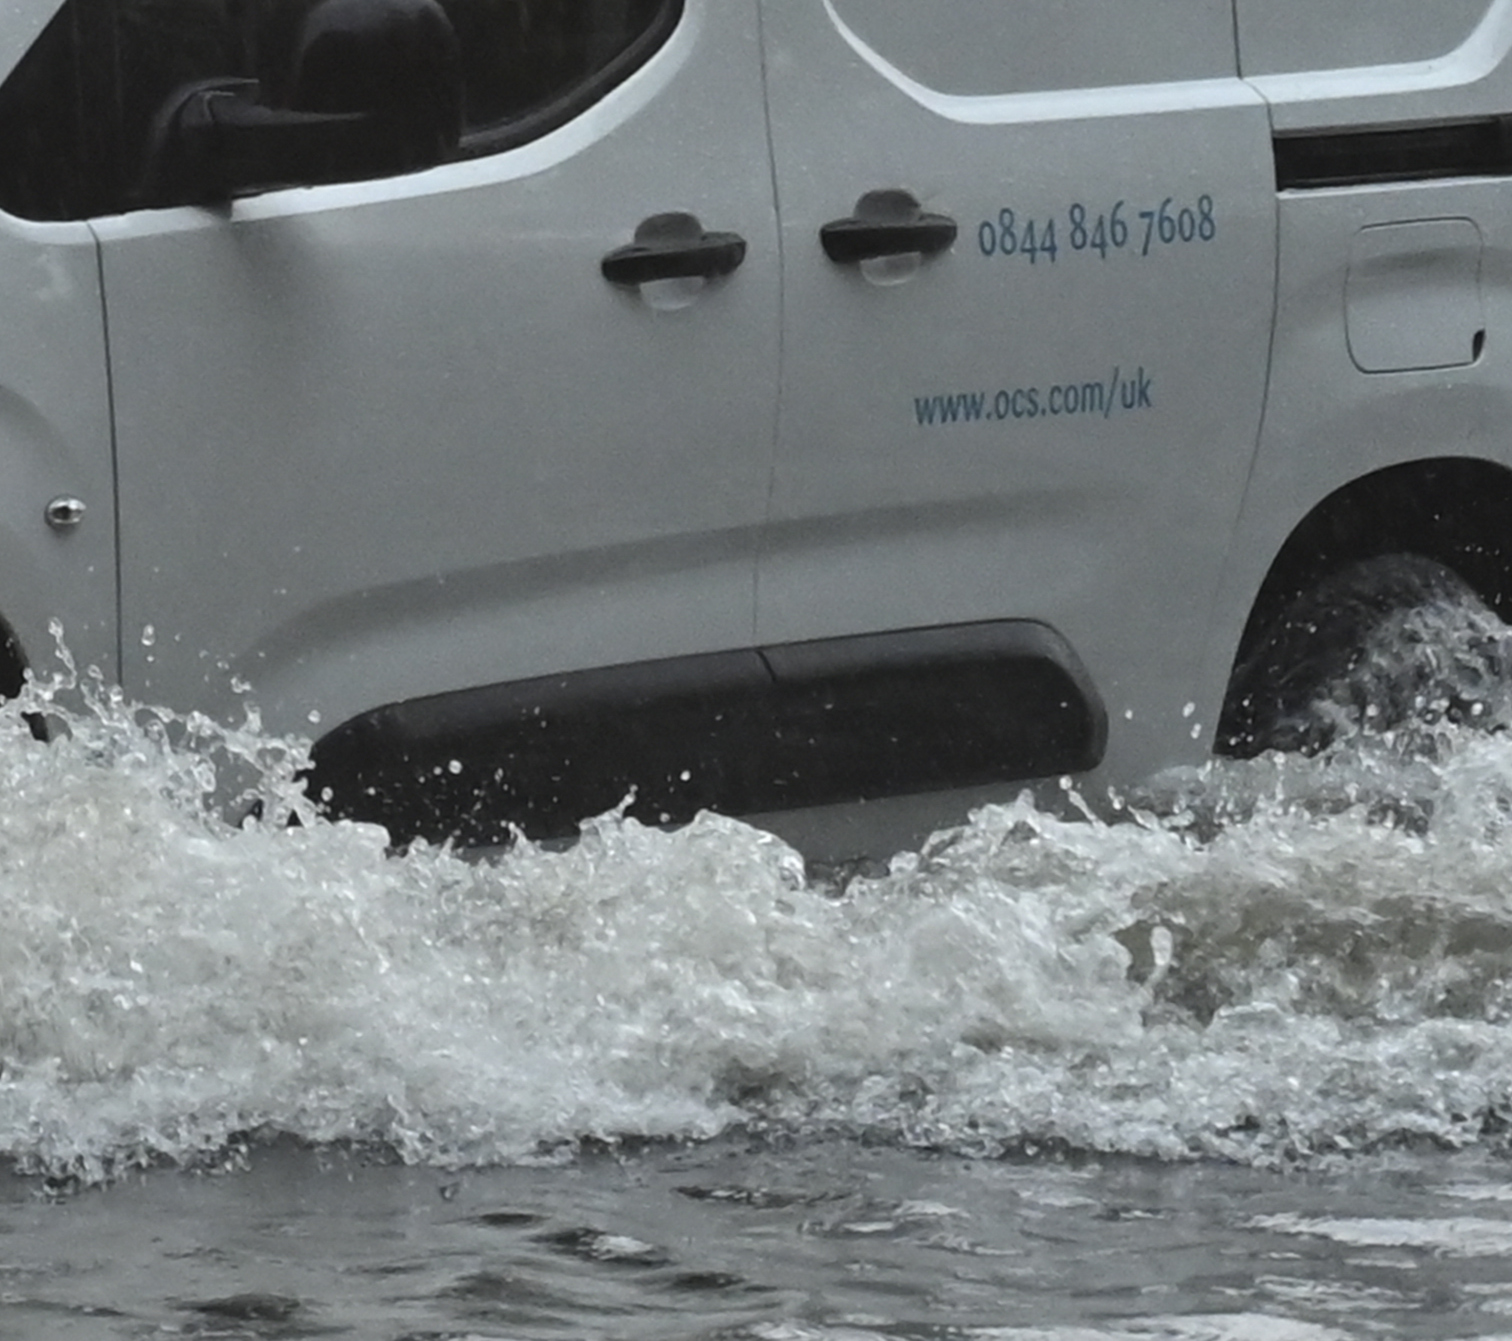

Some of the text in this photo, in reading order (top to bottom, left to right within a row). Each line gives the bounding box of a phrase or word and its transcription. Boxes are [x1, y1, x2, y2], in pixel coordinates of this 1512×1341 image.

[978, 193, 1216, 265] 0844 846 7608
[914, 365, 1152, 425] www.ocs.com/uk
